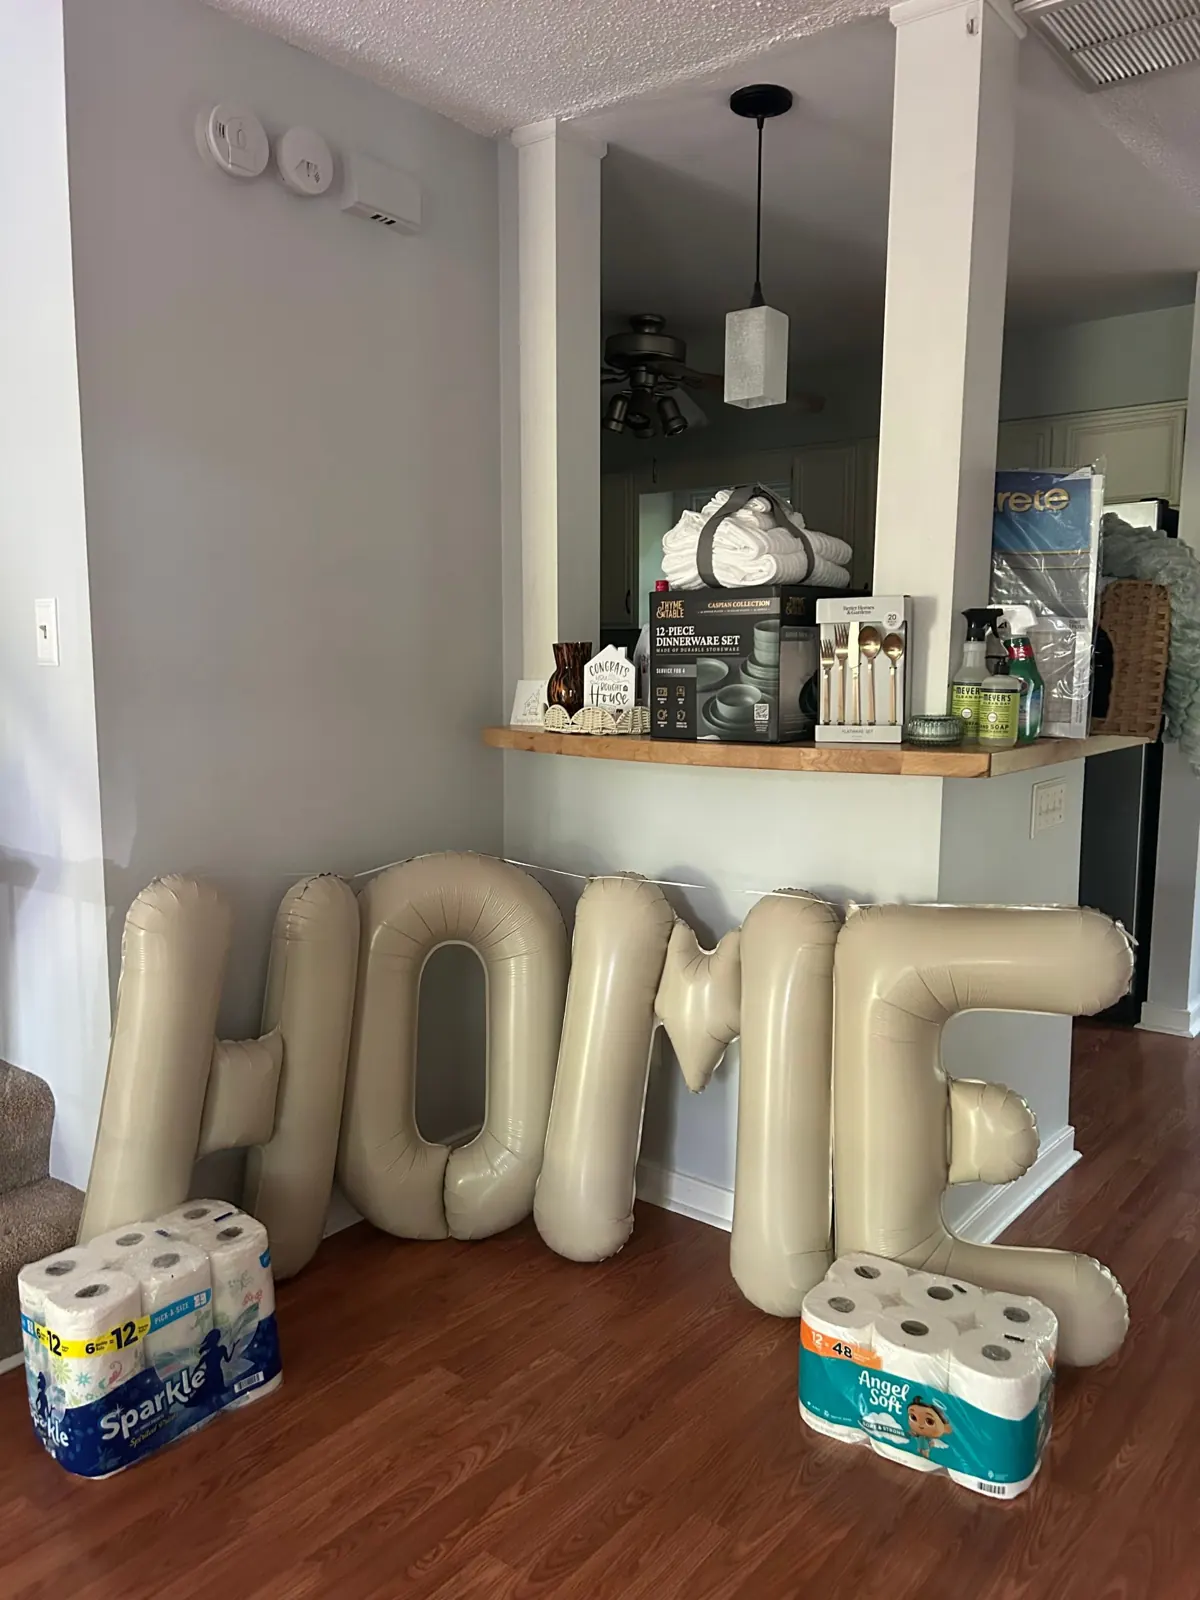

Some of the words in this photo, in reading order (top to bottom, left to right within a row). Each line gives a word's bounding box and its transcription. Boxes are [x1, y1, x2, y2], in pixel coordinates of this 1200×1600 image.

[660, 600, 685, 609] THYME
[733, 600, 771, 608] COLLECTION
[887, 613, 897, 621] 20
[656, 626, 695, 637] 12-PIECE
[656, 636, 720, 647] DINNERWARE
[721, 635, 741, 646] SET
[589, 661, 630, 678] CONGRATS
[85, 1343, 96, 1355] 6
[111, 1321, 139, 1350] 12
[811, 1331, 823, 1345] 12
[832, 1342, 853, 1359] 48
[858, 1370, 910, 1402] Angel
[100, 1367, 207, 1441] Sparkle
[869, 1388, 903, 1415] Soft
